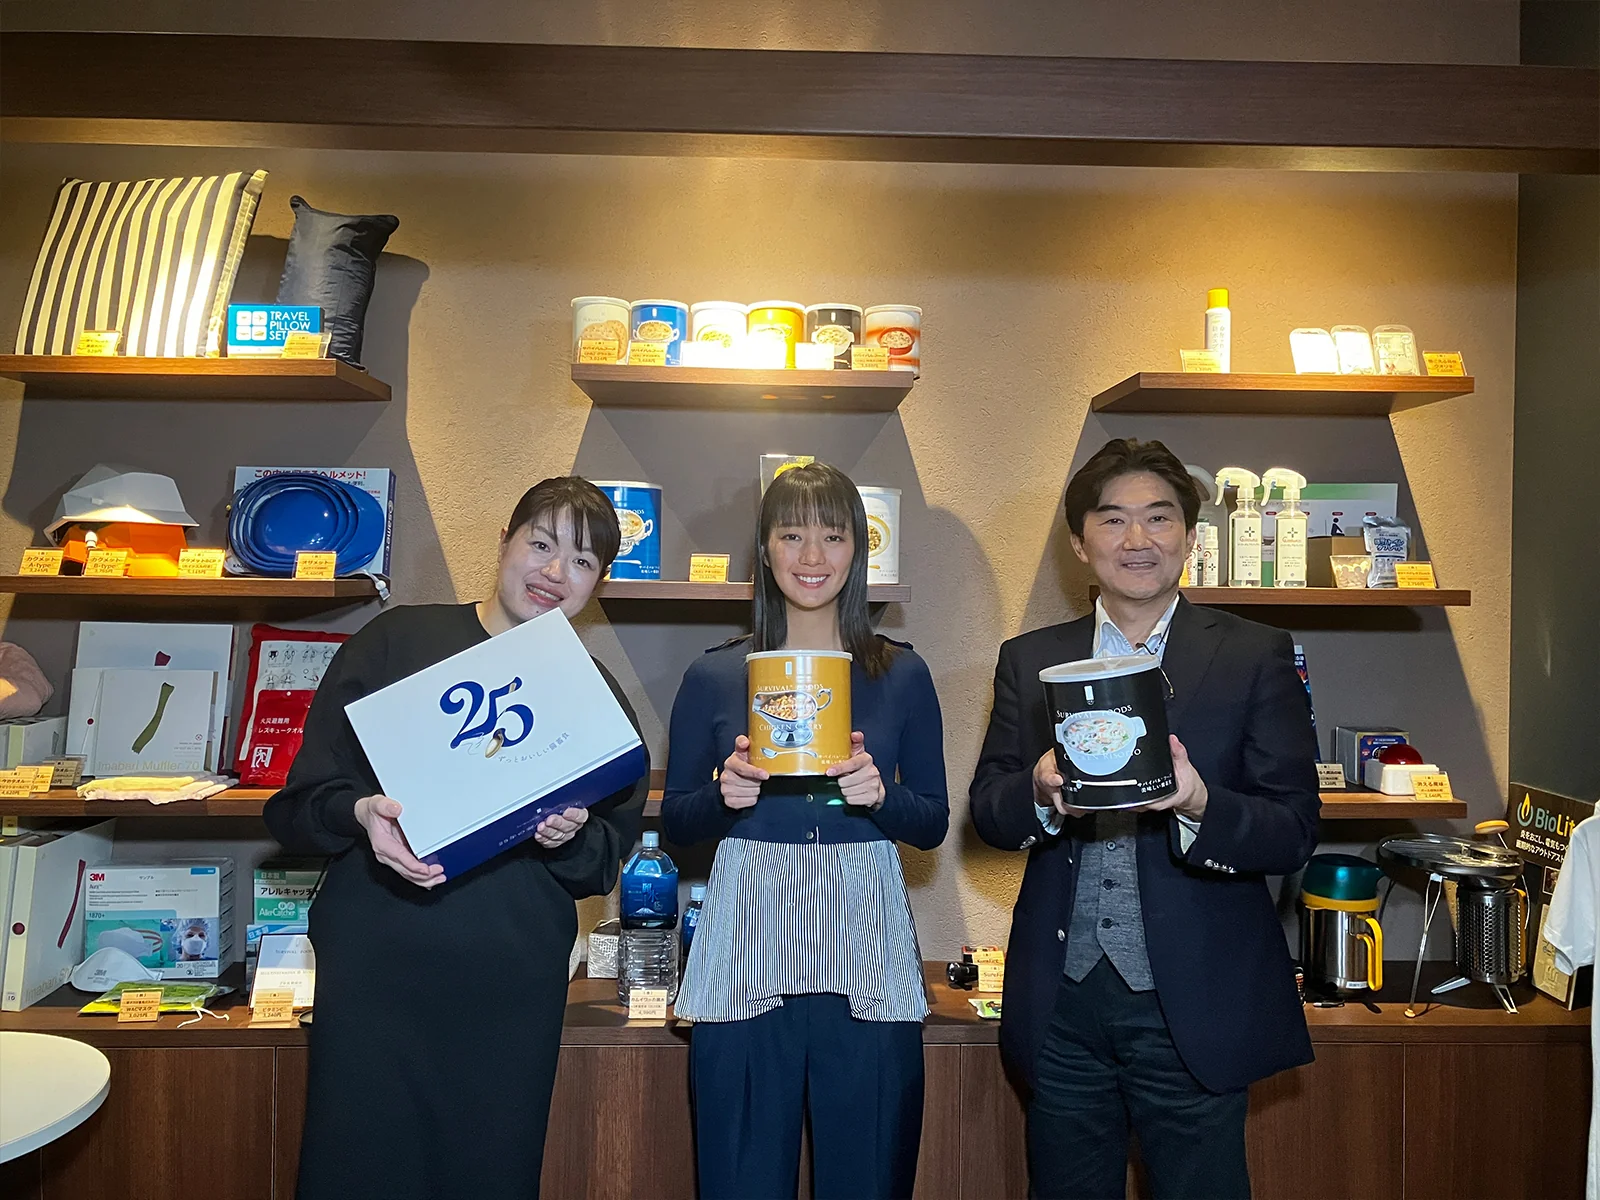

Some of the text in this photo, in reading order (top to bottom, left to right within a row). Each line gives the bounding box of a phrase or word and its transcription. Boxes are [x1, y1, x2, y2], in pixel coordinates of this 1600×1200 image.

[269, 311, 310, 321] TRAVEL
[269, 320, 311, 331] PILLOW
[268, 330, 287, 341] SET
[439, 676, 534, 749] 25
[142, 759, 181, 772] Muffler
[184, 760, 200, 771] 70
[89, 873, 106, 882] 3M
